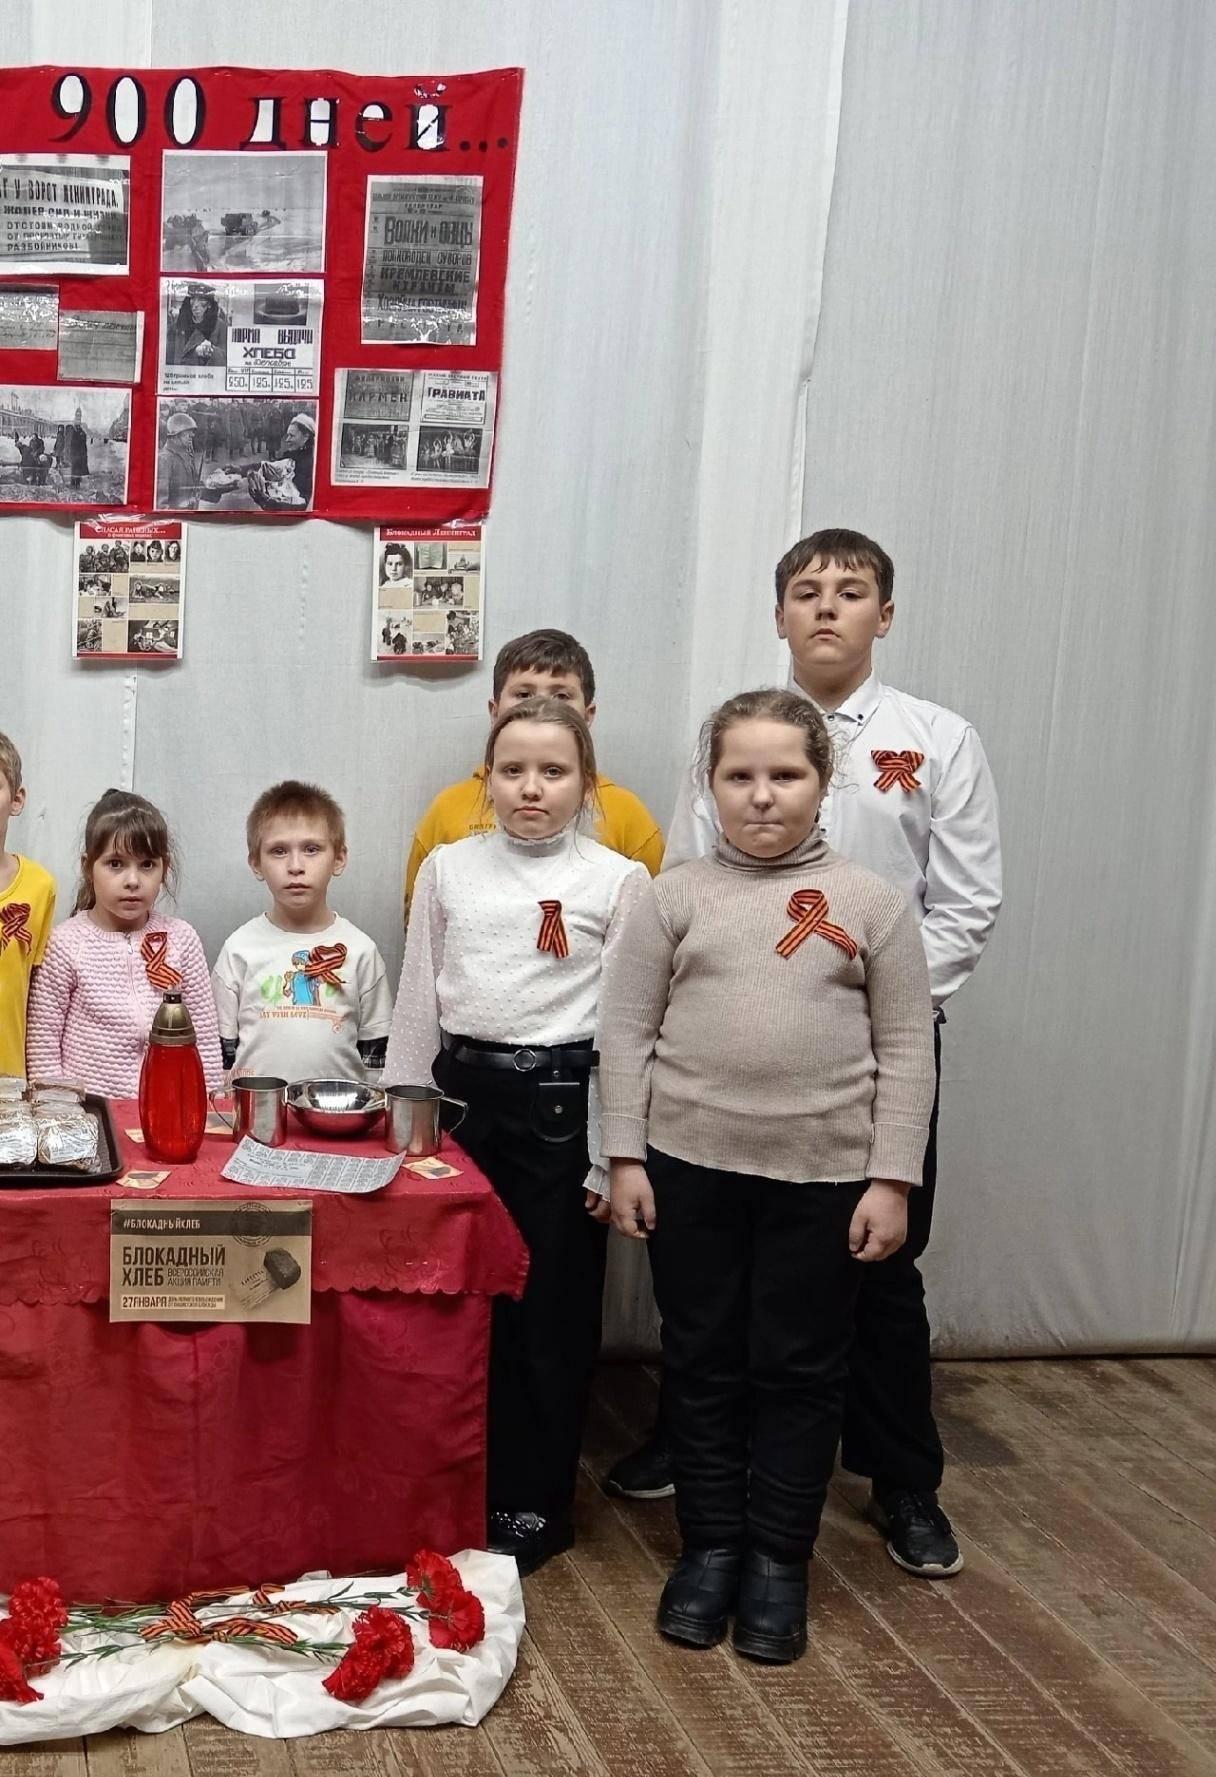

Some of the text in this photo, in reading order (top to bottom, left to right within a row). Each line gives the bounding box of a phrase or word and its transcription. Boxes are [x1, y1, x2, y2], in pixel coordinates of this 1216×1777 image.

[49, 74, 206, 149] 900
[14, 177, 21, 200] У
[242, 346, 296, 360] ХЛЕБА
[122, 1244, 226, 1267] БЛОКАДНЫЙ
[122, 1267, 164, 1287] ХЛЕБ
